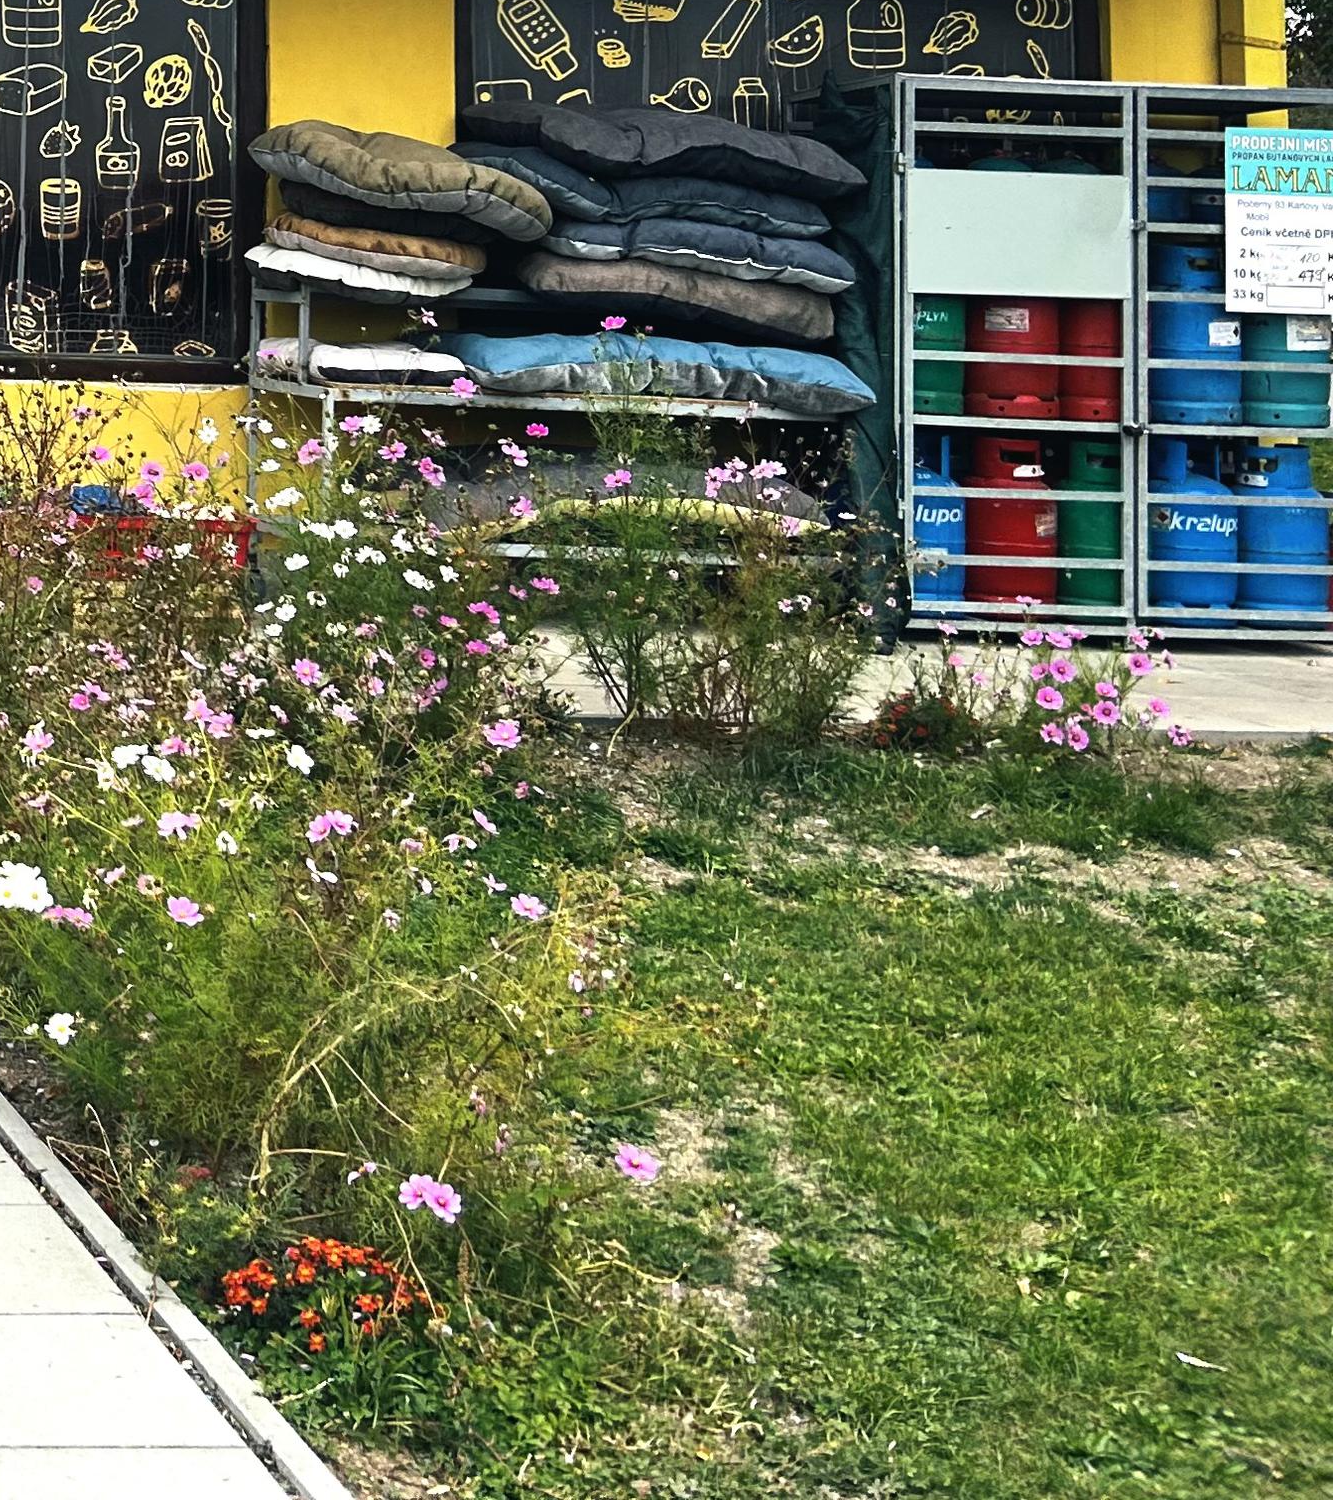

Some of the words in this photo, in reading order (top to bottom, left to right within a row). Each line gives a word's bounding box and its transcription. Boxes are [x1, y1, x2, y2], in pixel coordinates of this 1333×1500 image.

[1232, 151, 1265, 161] PROPAN
[1321, 154, 1333, 163] LA
[1275, 228, 1311, 239] včetně
[1239, 248, 1246, 258] 2
[1233, 268, 1246, 279] 10
[1233, 288, 1247, 299] 33
[1250, 289, 1264, 302] kg
[914, 504, 963, 527] lupo
[1169, 510, 1238, 537] kralup
